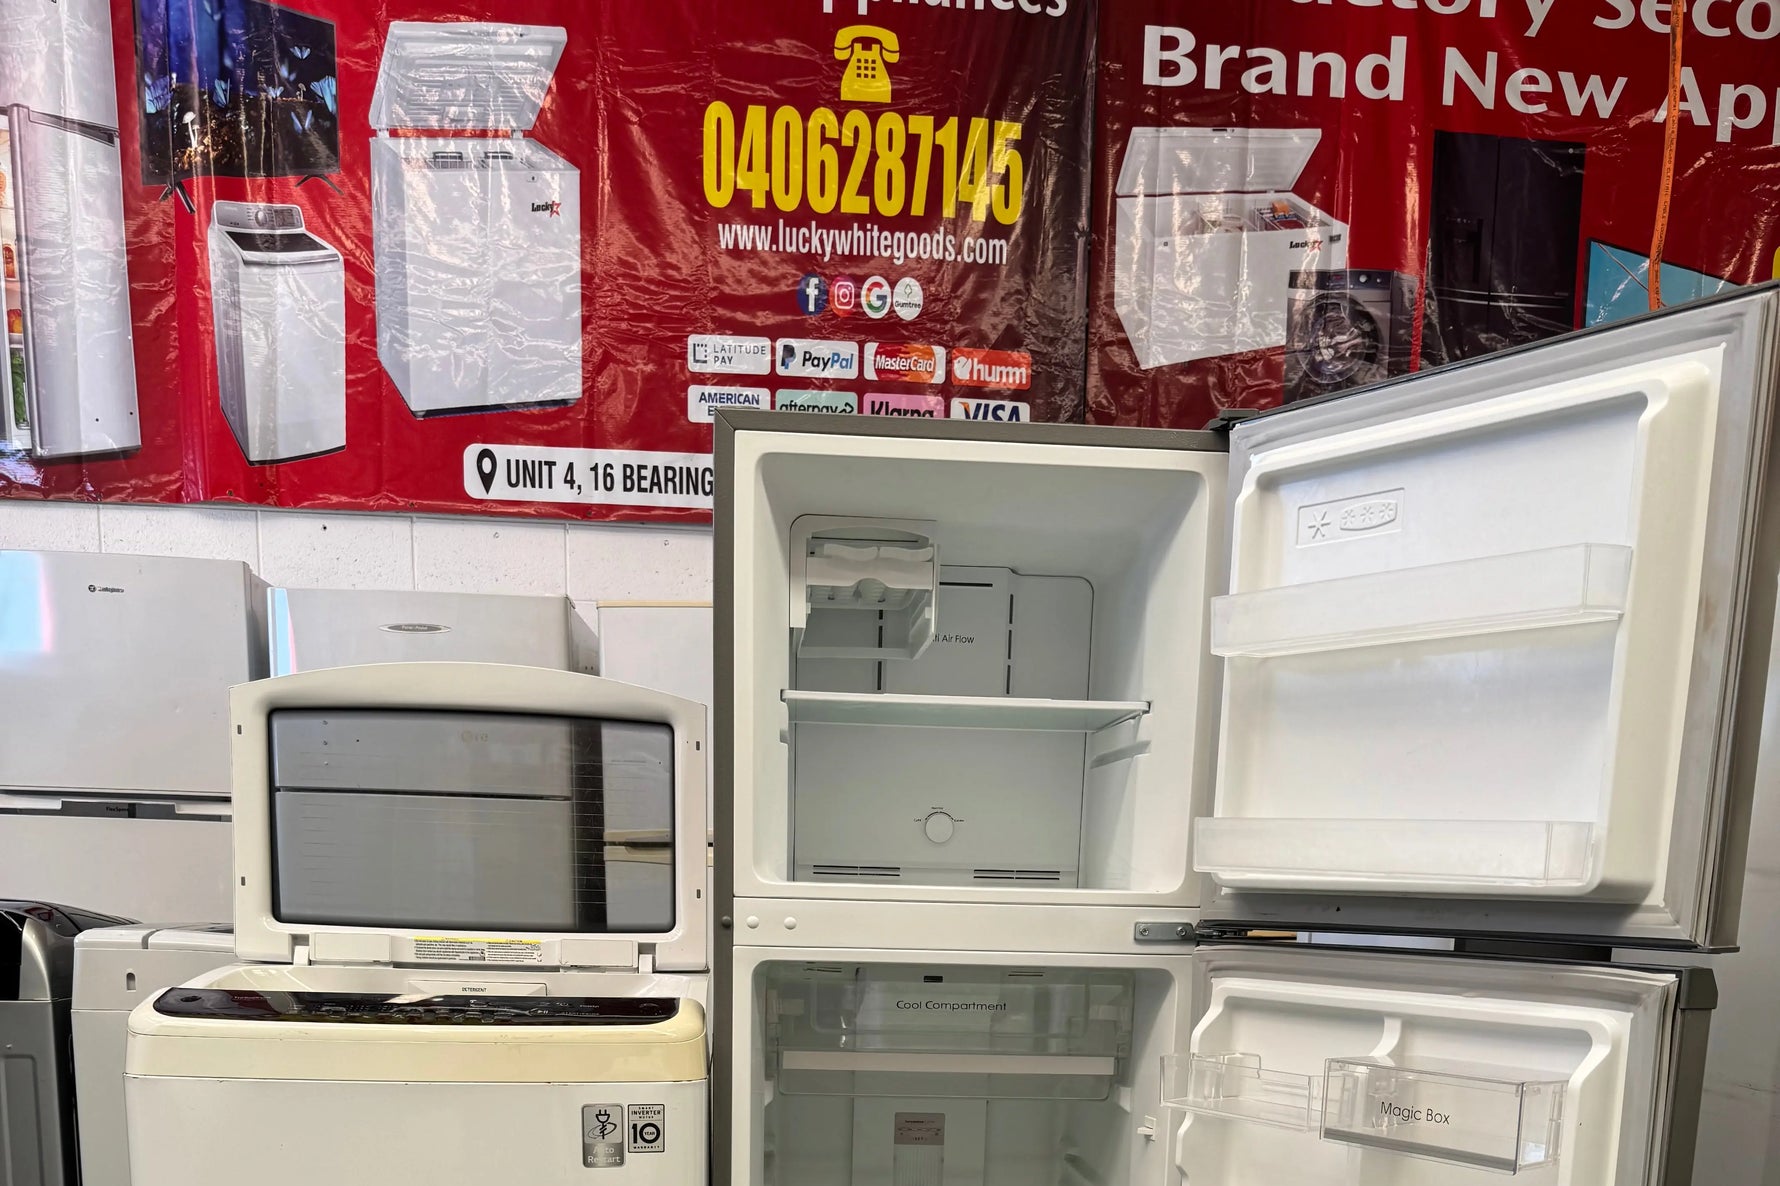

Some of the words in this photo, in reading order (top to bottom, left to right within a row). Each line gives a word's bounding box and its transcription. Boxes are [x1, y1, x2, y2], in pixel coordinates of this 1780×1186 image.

[1143, 25, 1407, 101] Brand
[1442, 47, 1628, 119] New
[1652, 66, 1780, 145] Ap
[702, 101, 1024, 225] 0406287145
[718, 219, 1008, 264] www.luckywhitegoods.com
[895, 300, 922, 309] Gumtree
[713, 344, 767, 355] LATITUDE
[713, 356, 734, 365] PAY
[802, 351, 854, 372] PayPal
[875, 354, 935, 373] MasterCard
[973, 356, 1027, 384] humm
[699, 392, 760, 405] AMERICAN
[959, 402, 1021, 422] VISA
[506, 459, 557, 489] UNIT
[563, 462, 583, 495] 4,
[590, 463, 615, 492] 16
[623, 464, 713, 496] BEARING
[955, 635, 975, 643] Flow
[896, 1000, 921, 1009] Cool
[925, 1000, 1006, 1011] Compartment
[1381, 1102, 1422, 1121] Magic
[1426, 1108, 1450, 1125] Box
[632, 1122, 661, 1144] 10
